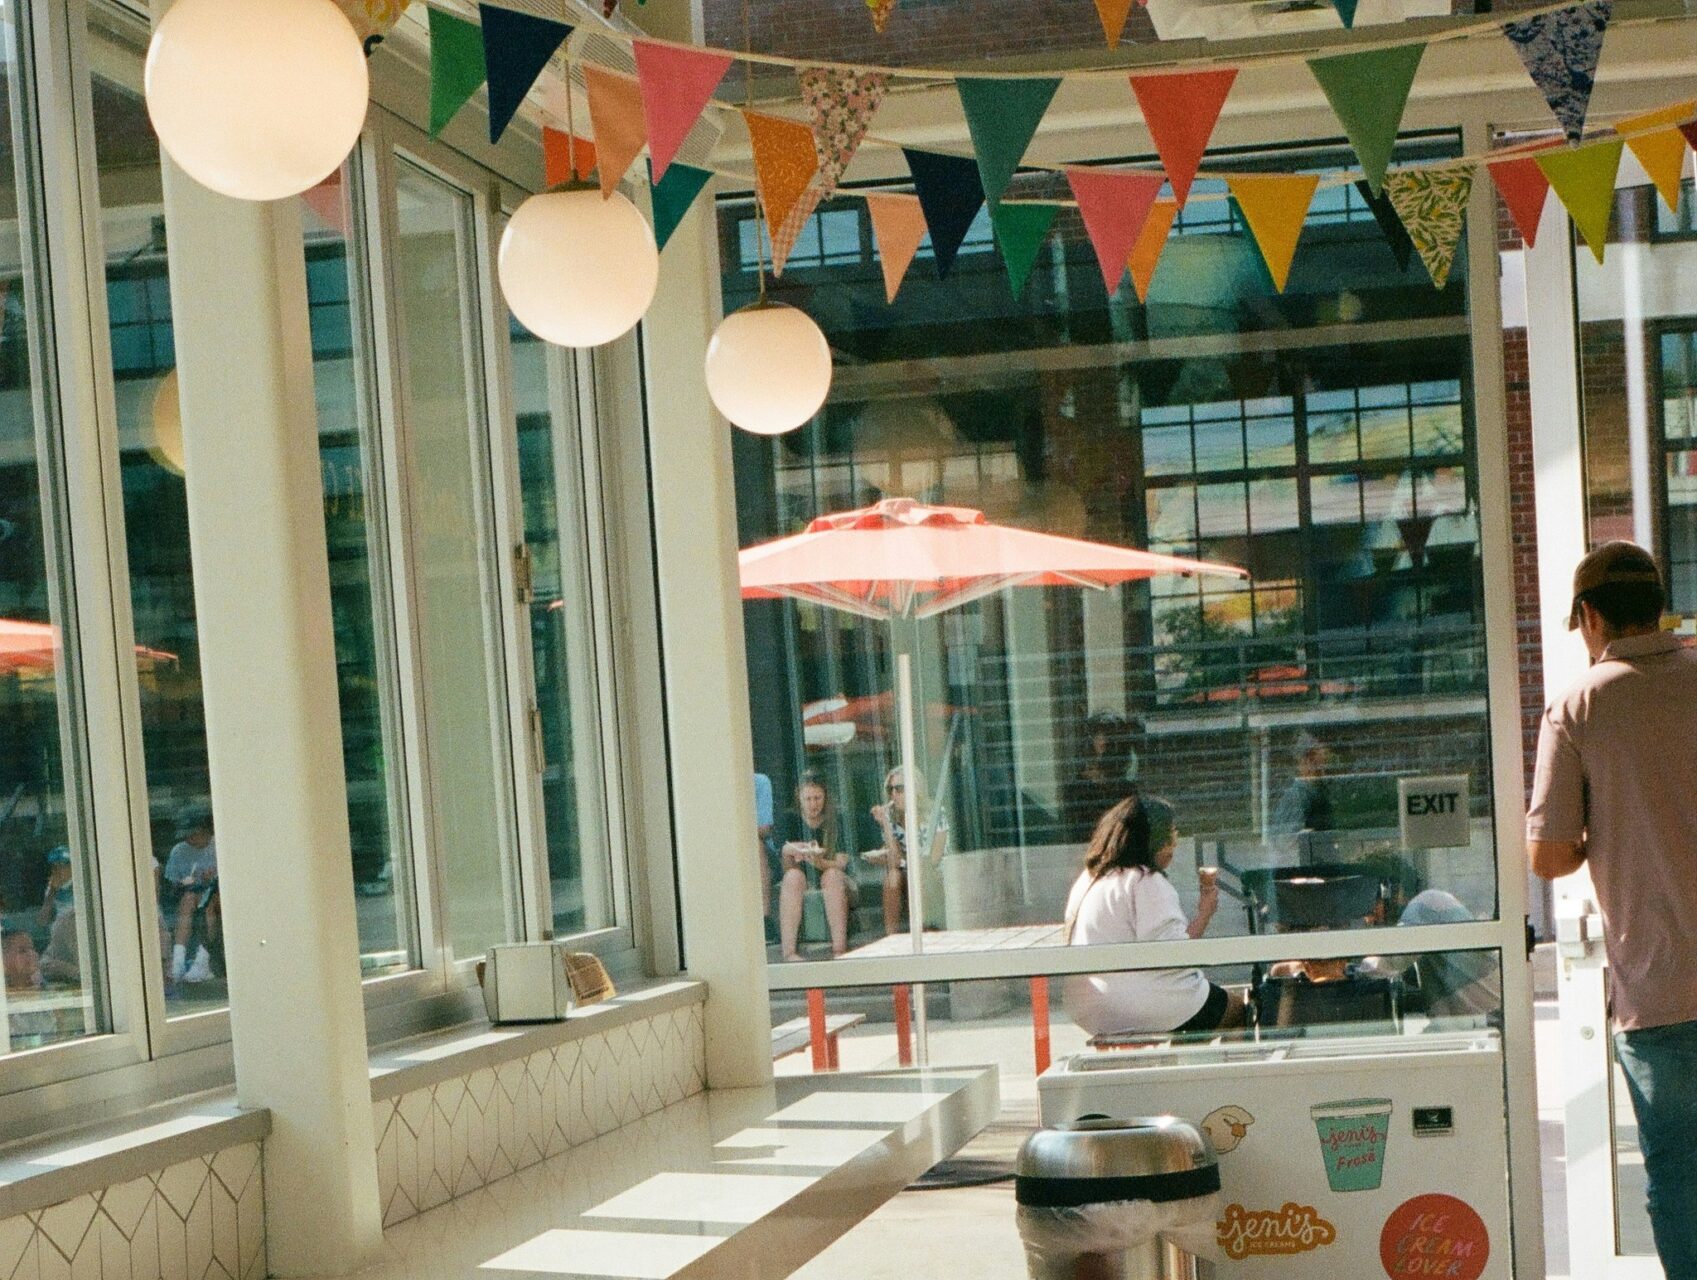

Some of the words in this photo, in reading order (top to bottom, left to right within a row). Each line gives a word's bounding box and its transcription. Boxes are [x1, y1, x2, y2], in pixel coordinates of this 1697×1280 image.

[1406, 792, 1459, 816] EXIT
[1321, 1124, 1386, 1151] jeni's
[1217, 1209, 1328, 1253] jeni's
[1409, 1212, 1450, 1233] ICE
[1249, 1241, 1263, 1249] ICE
[1396, 1234, 1474, 1258] CREAM
[1393, 1257, 1463, 1278] LOVER
